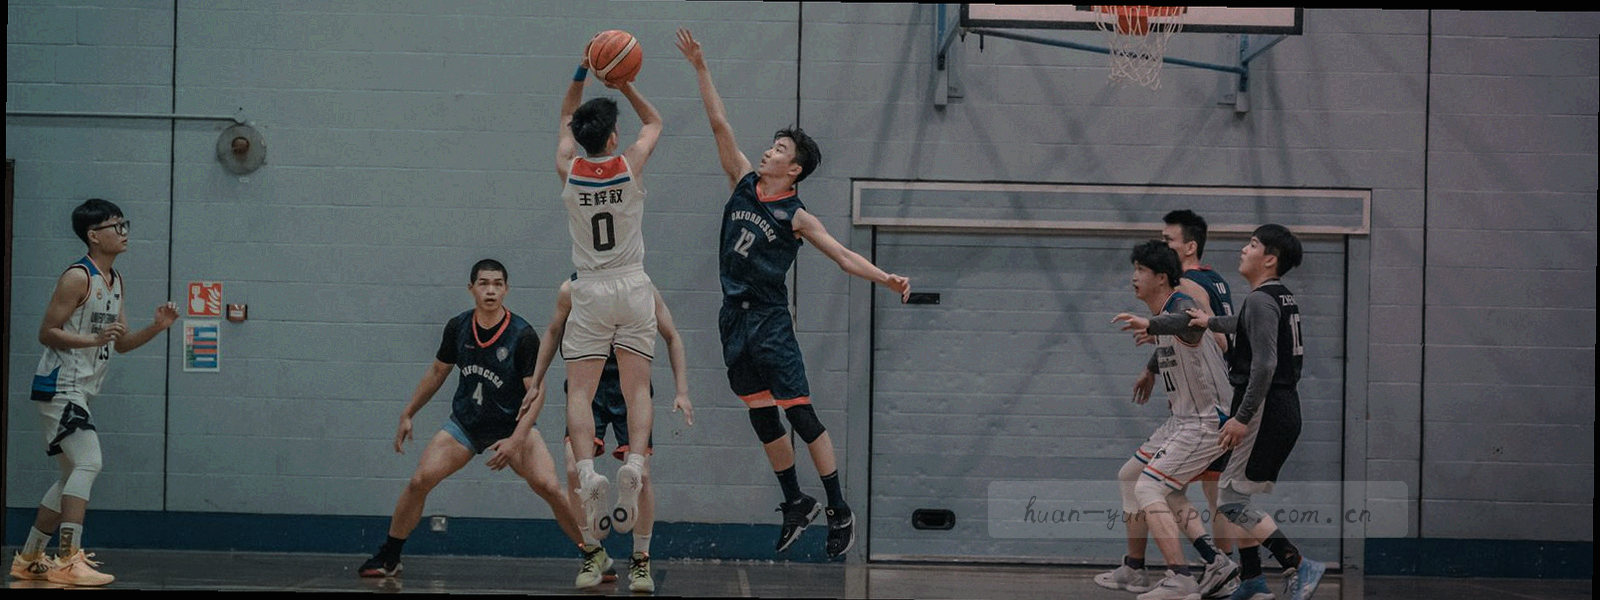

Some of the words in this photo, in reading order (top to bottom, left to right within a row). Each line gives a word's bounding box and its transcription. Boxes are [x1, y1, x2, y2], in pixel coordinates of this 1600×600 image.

[591, 211, 616, 252] 0
[734, 227, 756, 258] 12
[472, 382, 483, 406] 4
